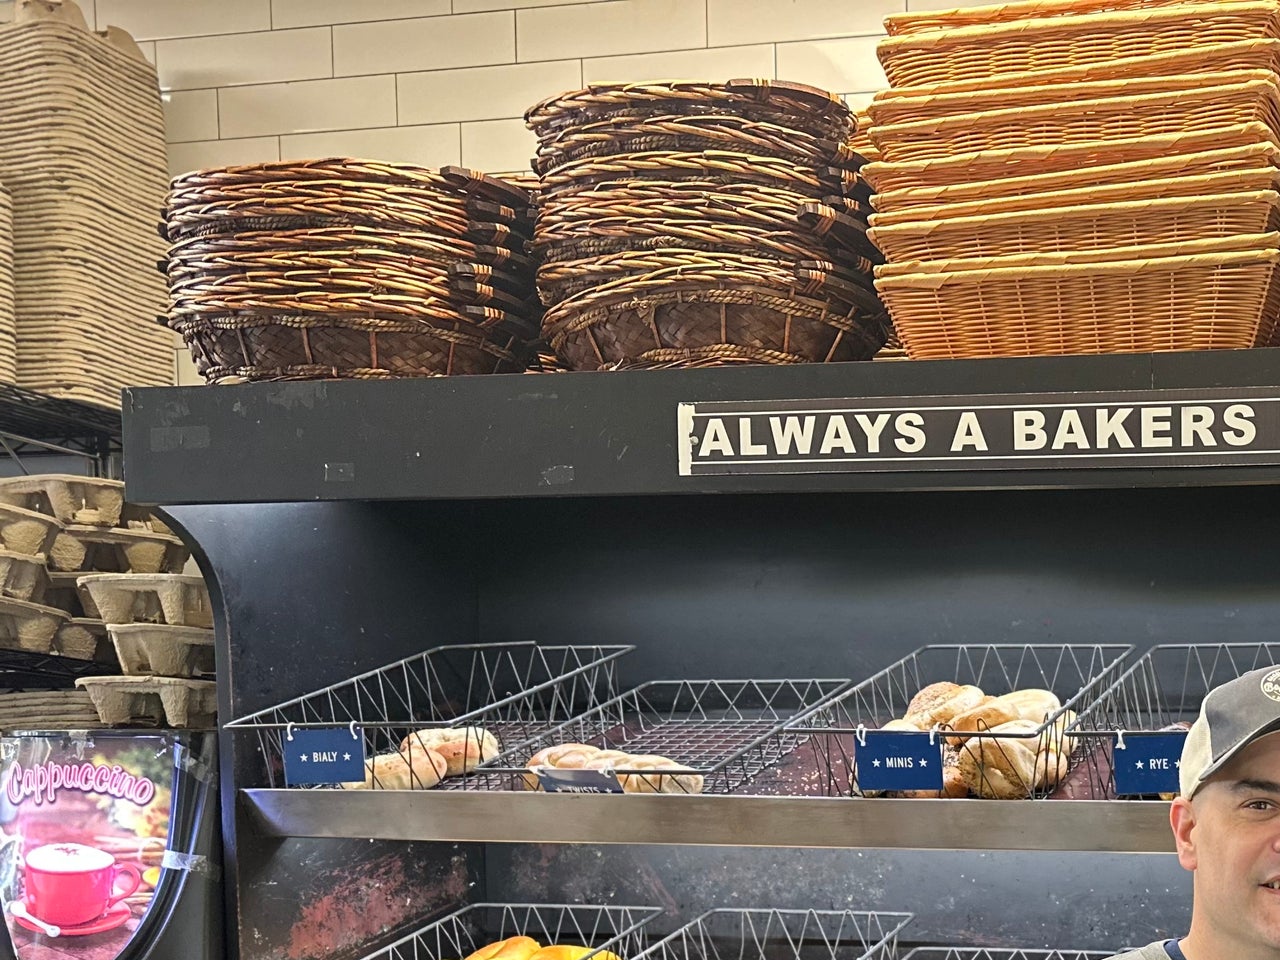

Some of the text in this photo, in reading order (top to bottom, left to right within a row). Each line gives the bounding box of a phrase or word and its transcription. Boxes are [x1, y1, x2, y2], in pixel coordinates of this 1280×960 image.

[698, 412, 927, 457] ALWAYS
[950, 410, 990, 451] A
[1012, 403, 1257, 450] BAKERS
[313, 751, 338, 763] BIALY
[885, 757, 914, 769] MINIS
[1149, 758, 1170, 770] RYE
[7, 760, 156, 804] Cappuccino
